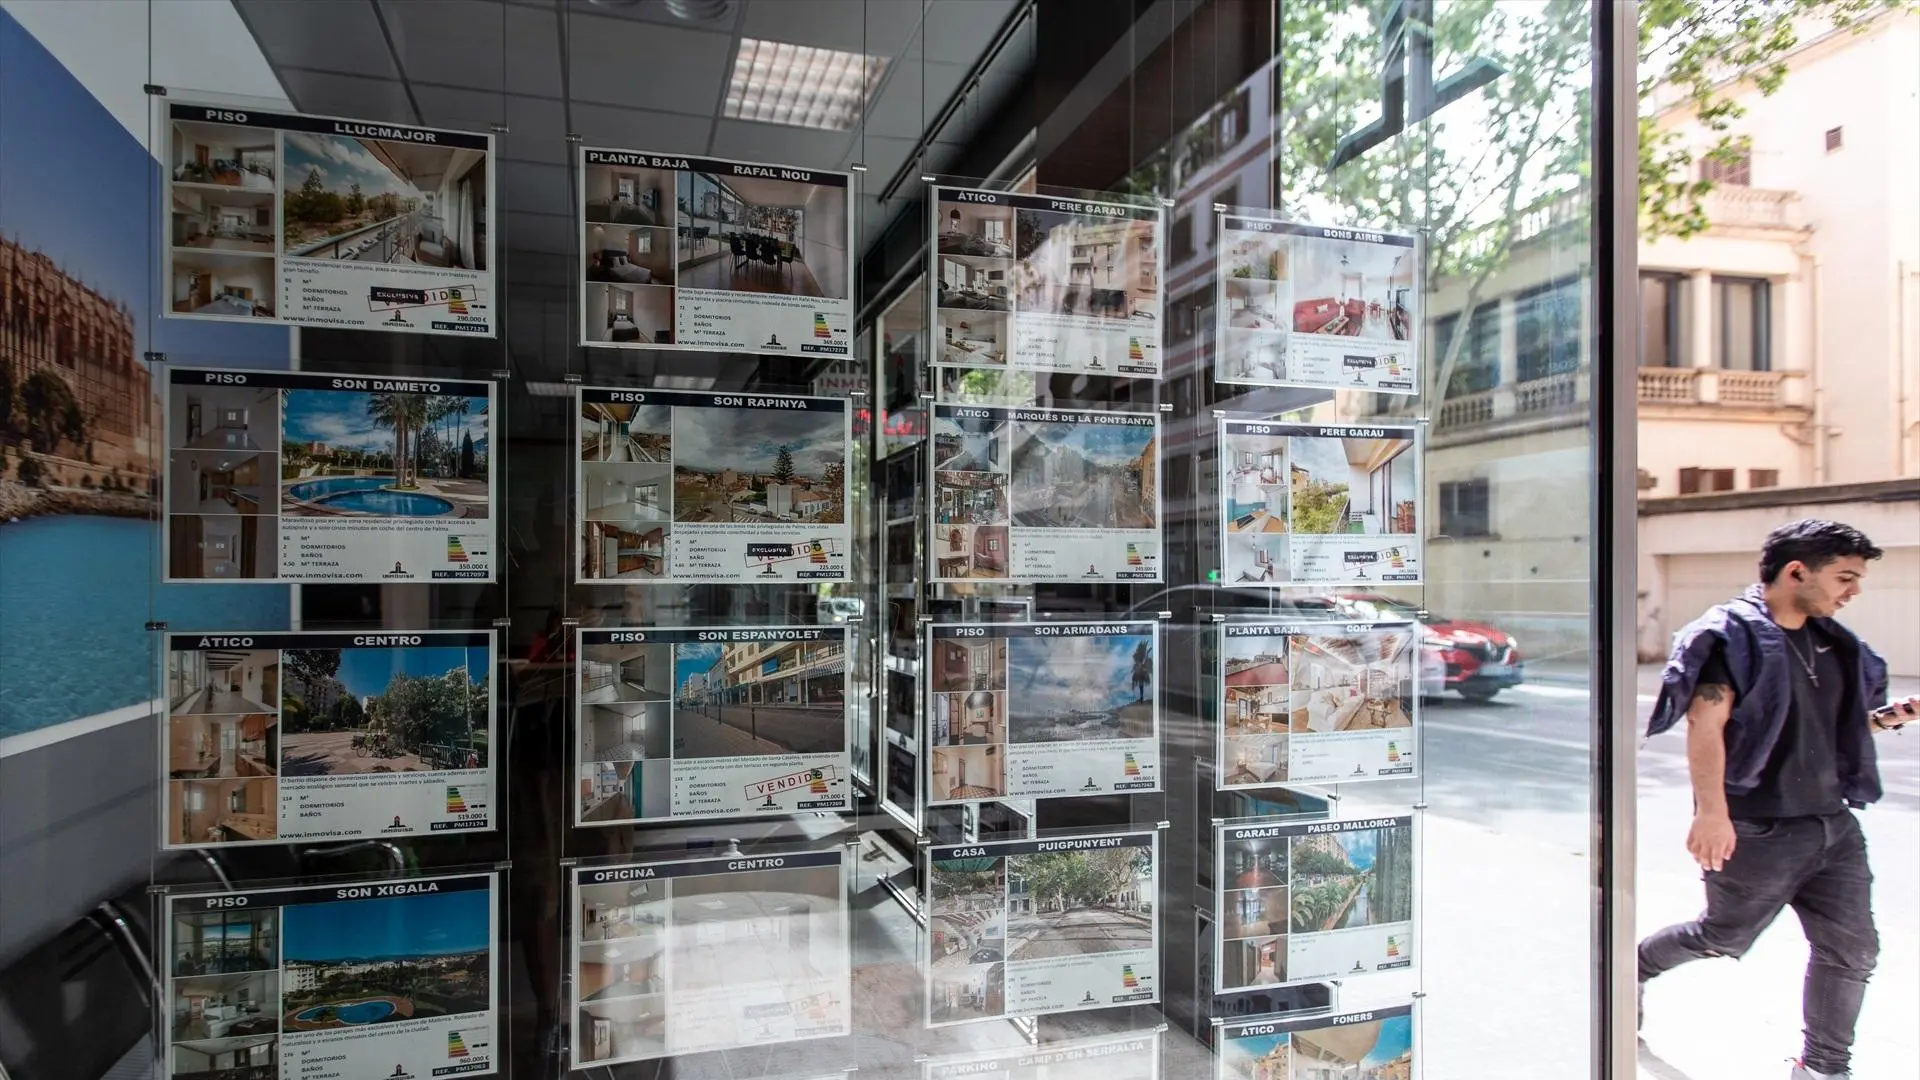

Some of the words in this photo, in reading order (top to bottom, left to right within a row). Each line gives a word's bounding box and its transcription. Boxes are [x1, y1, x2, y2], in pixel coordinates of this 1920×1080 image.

[206, 110, 248, 123] PISO
[335, 123, 437, 142] LLUCMAJOR
[590, 152, 647, 166] PLANTA
[652, 158, 690, 169] BAJA
[734, 165, 777, 178] RAFAL
[782, 170, 810, 181] NOU
[958, 191, 996, 203] ÁTICO
[1052, 201, 1082, 212] PERE
[1086, 204, 1125, 216] GARAU
[1247, 222, 1272, 231] PISO
[1323, 230, 1352, 240] BONS
[1354, 233, 1384, 243] AIRES
[282, 316, 365, 325] www.inmovisa.com
[677, 340, 745, 348] www.inmovisa.com
[206, 374, 247, 384] PISO
[332, 380, 367, 390] SON
[374, 382, 441, 393] DAMETO
[610, 392, 645, 402] PISO
[714, 397, 743, 406] SON
[748, 398, 807, 409] RAPINYA
[956, 408, 990, 418] ÁTICO
[1008, 411, 1058, 422] MARQUÉS
[1062, 414, 1075, 422] DE
[1078, 415, 1092, 423] LA
[1094, 416, 1154, 426] FONTSANTA
[1246, 426, 1270, 434] PISO
[1320, 428, 1346, 437] PERE
[1349, 429, 1384, 437] GARAU
[610, 632, 645, 642] PISO
[698, 632, 728, 641] SON
[733, 630, 821, 640] ESPANYOLET
[956, 628, 985, 636] PISO
[1034, 627, 1059, 635] SON
[1063, 626, 1128, 635] ARMADANS
[1228, 627, 1271, 636] PLANTA
[1274, 626, 1301, 635] BAJA
[1346, 624, 1374, 633] CORT
[198, 636, 254, 648] ÁTICO
[354, 636, 422, 646] CENTRO
[757, 770, 823, 794] VENDIDO
[1009, 789, 1066, 797] www.inmovisa.com
[673, 808, 741, 817] www.inmovisa.com
[280, 830, 362, 839] www.inmovisa.com
[1236, 828, 1279, 839] GARAJE
[1308, 822, 1341, 834] PASEO
[1343, 819, 1396, 831] MALLORCA
[953, 848, 986, 858] CASA
[1038, 838, 1123, 851] PUIGPUNYENT
[594, 868, 656, 882] OFICINA
[728, 858, 784, 870] CENTRO
[206, 896, 248, 908] PISO
[337, 889, 371, 900] SON
[377, 882, 439, 897] XIGALA
[1241, 1025, 1275, 1037] ÁTICO
[1333, 1013, 1373, 1025] FONERS
[301, 1055, 346, 1064] DORMITORIOS
[942, 1061, 998, 1076] PARKING
[1086, 1041, 1144, 1058] SERRALTA
[312, 1072, 340, 1080] TERRAZA
